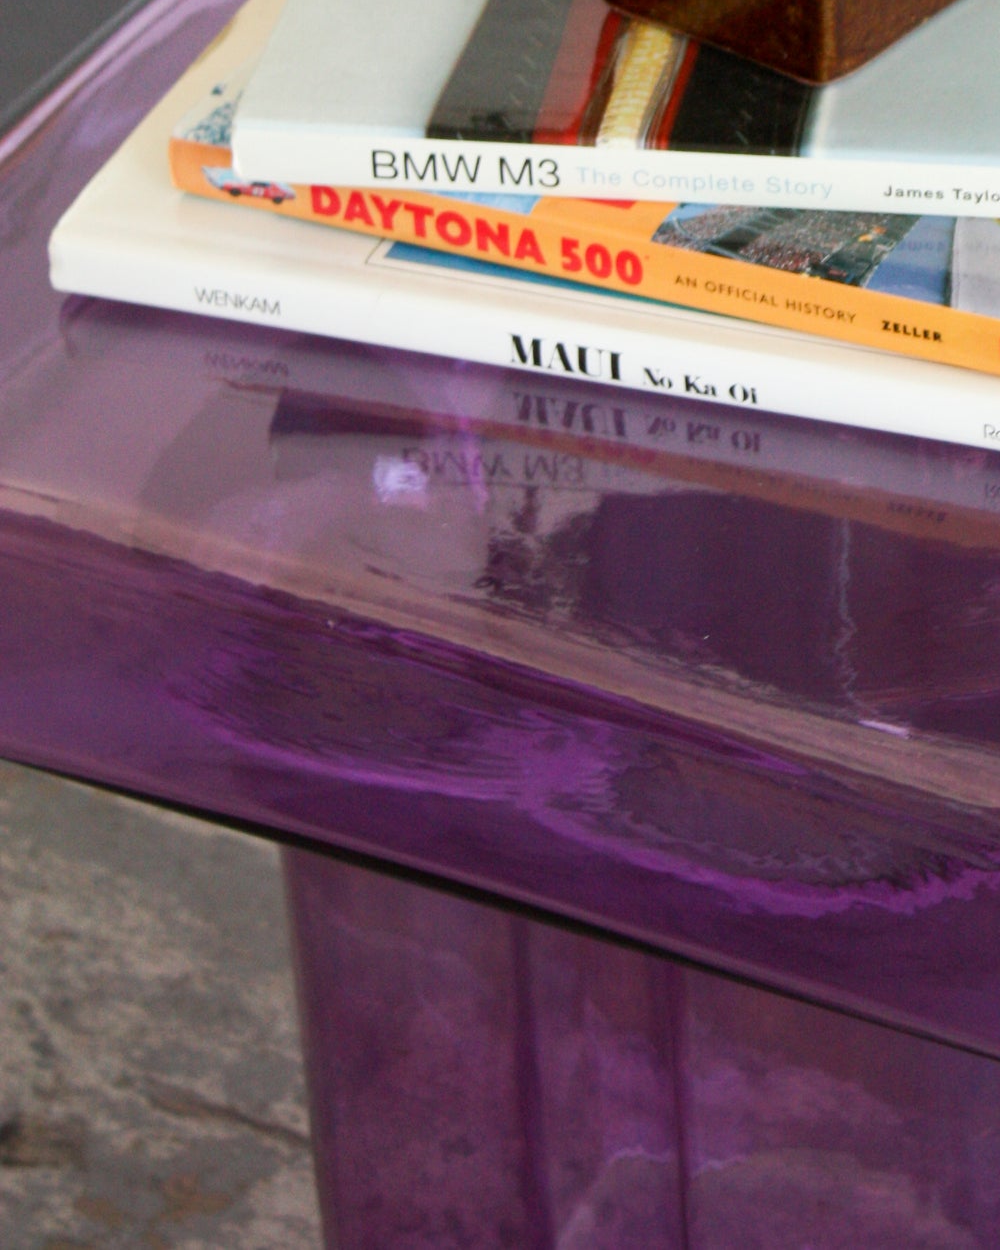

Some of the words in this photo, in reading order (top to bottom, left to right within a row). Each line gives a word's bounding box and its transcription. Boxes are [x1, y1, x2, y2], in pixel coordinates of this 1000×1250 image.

[371, 149, 481, 183] BMW
[498, 156, 561, 188] M3
[575, 166, 623, 184] The
[632, 169, 756, 194] Complete
[765, 175, 834, 199] Story
[883, 184, 945, 200] James
[310, 184, 547, 266] DAYTONA
[560, 236, 644, 286] 500
[193, 285, 282, 316] WENKAM
[674, 274, 698, 289] AN
[703, 280, 779, 308] OFFICIAL
[784, 297, 857, 324] HISTORY
[881, 319, 943, 343] ZELLER
[509, 334, 623, 382] MAUI
[642, 366, 673, 390] No
[683, 374, 718, 398] Ka
[727, 382, 758, 405] Oi
